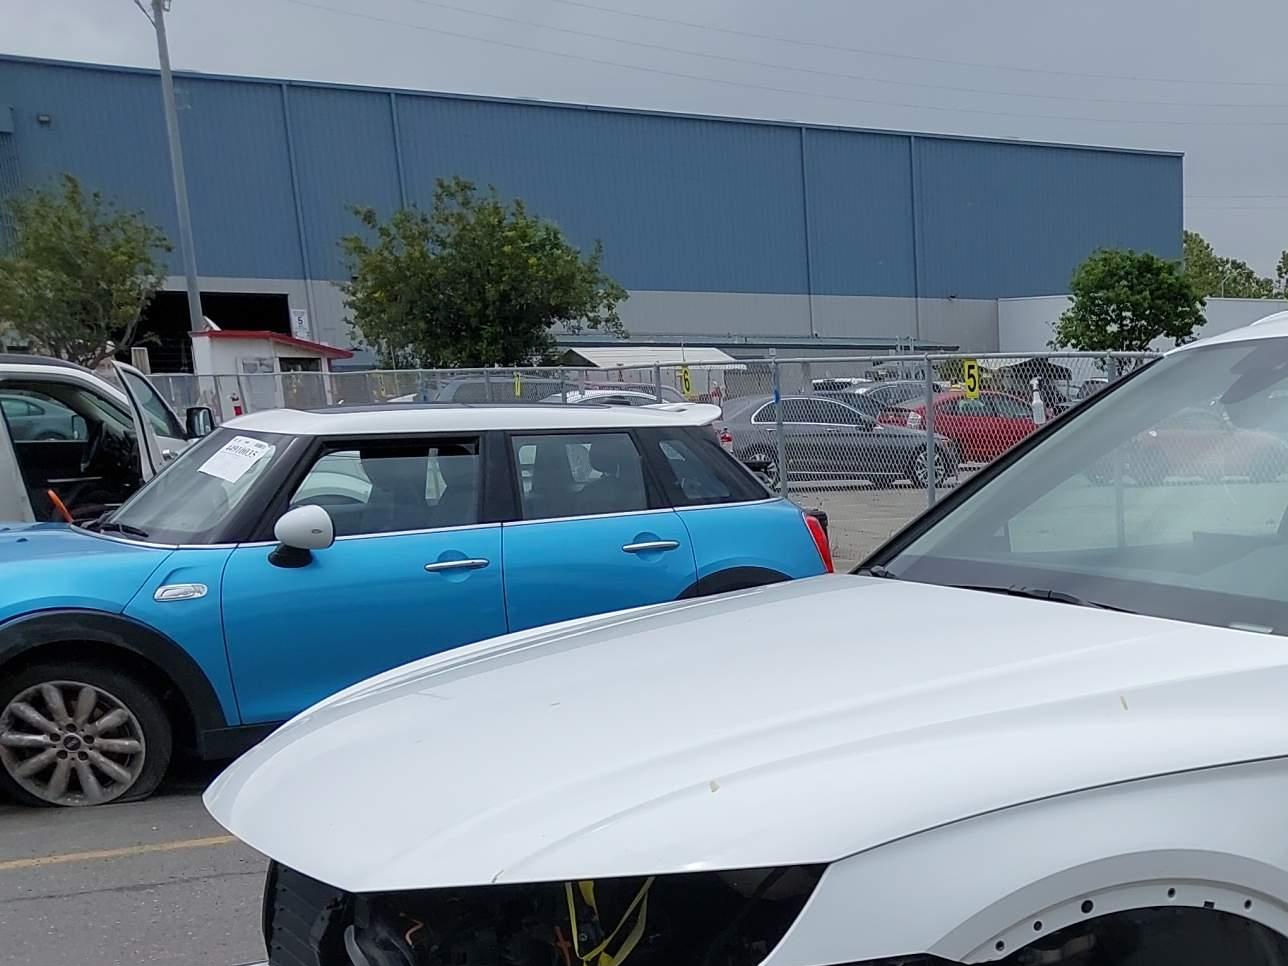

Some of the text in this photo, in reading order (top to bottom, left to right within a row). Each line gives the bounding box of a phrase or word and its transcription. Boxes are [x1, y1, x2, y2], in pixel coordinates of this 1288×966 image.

[297, 316, 303, 325] 5
[683, 369, 690, 392] 6
[967, 364, 977, 392] 5
